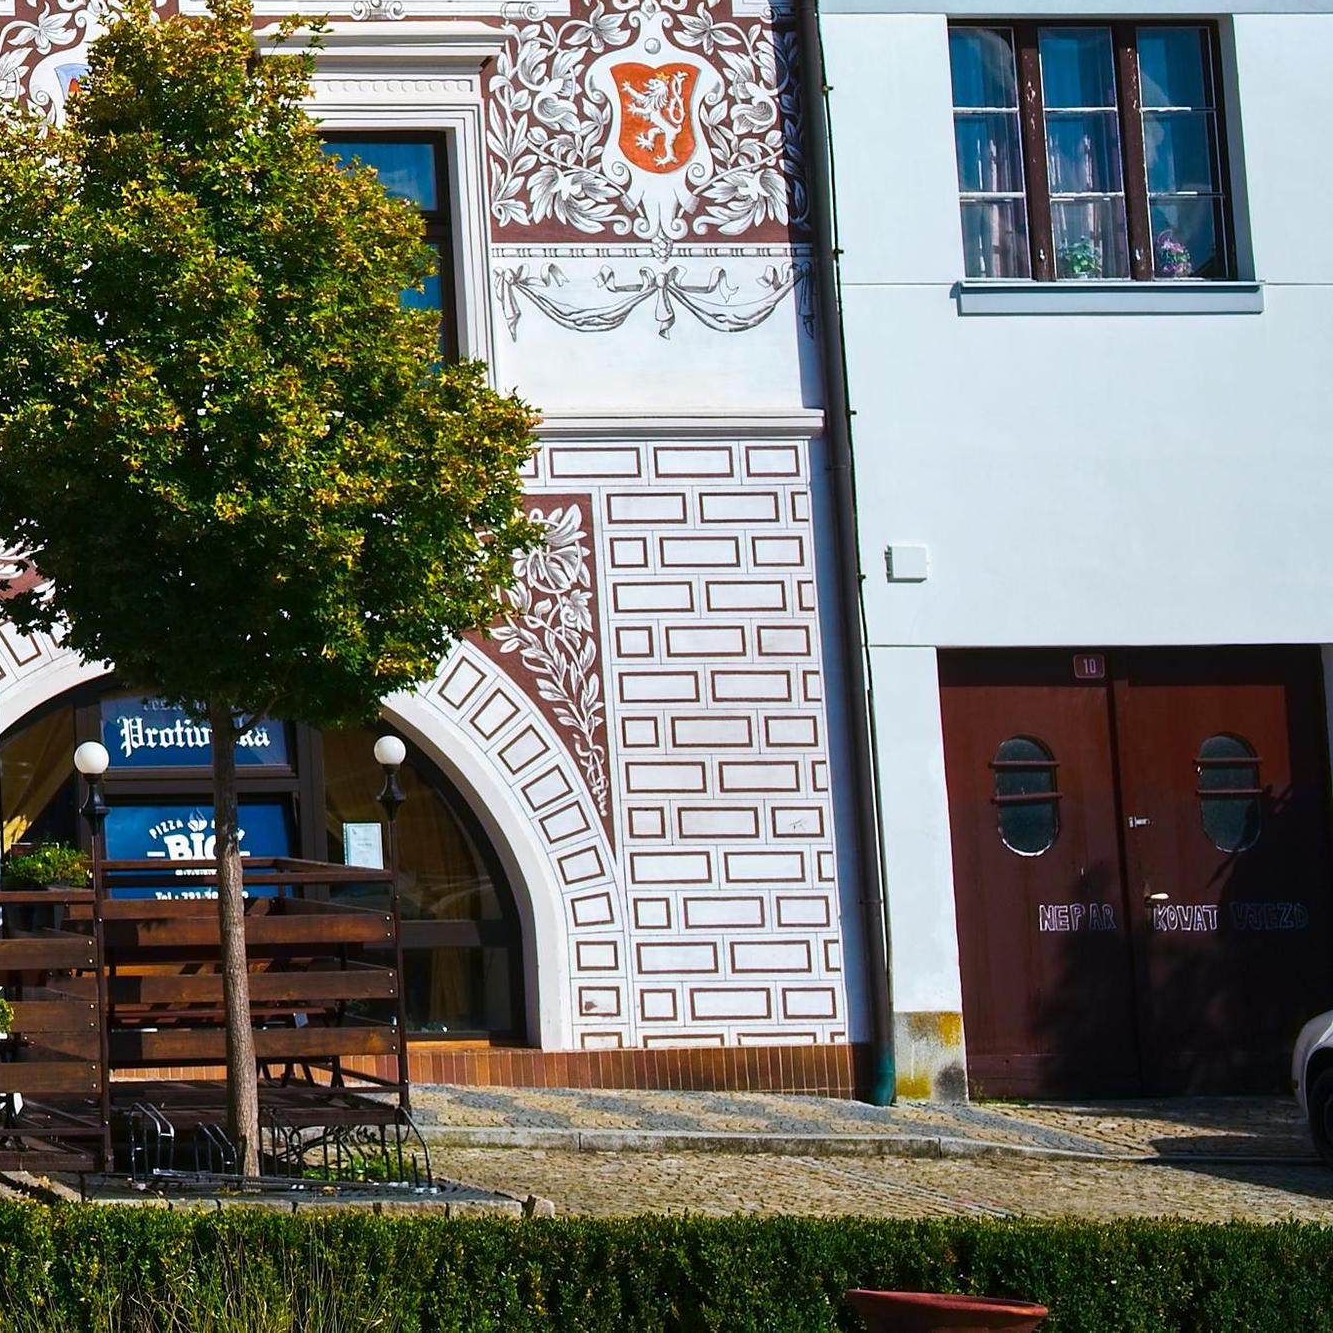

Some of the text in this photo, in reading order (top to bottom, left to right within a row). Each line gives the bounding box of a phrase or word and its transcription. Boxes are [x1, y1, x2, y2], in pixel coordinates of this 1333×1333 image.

[1083, 658, 1096, 674] 10
[117, 715, 271, 758] Protivka
[149, 819, 184, 840] PIZZA
[1153, 904, 1219, 932] KOVAT
